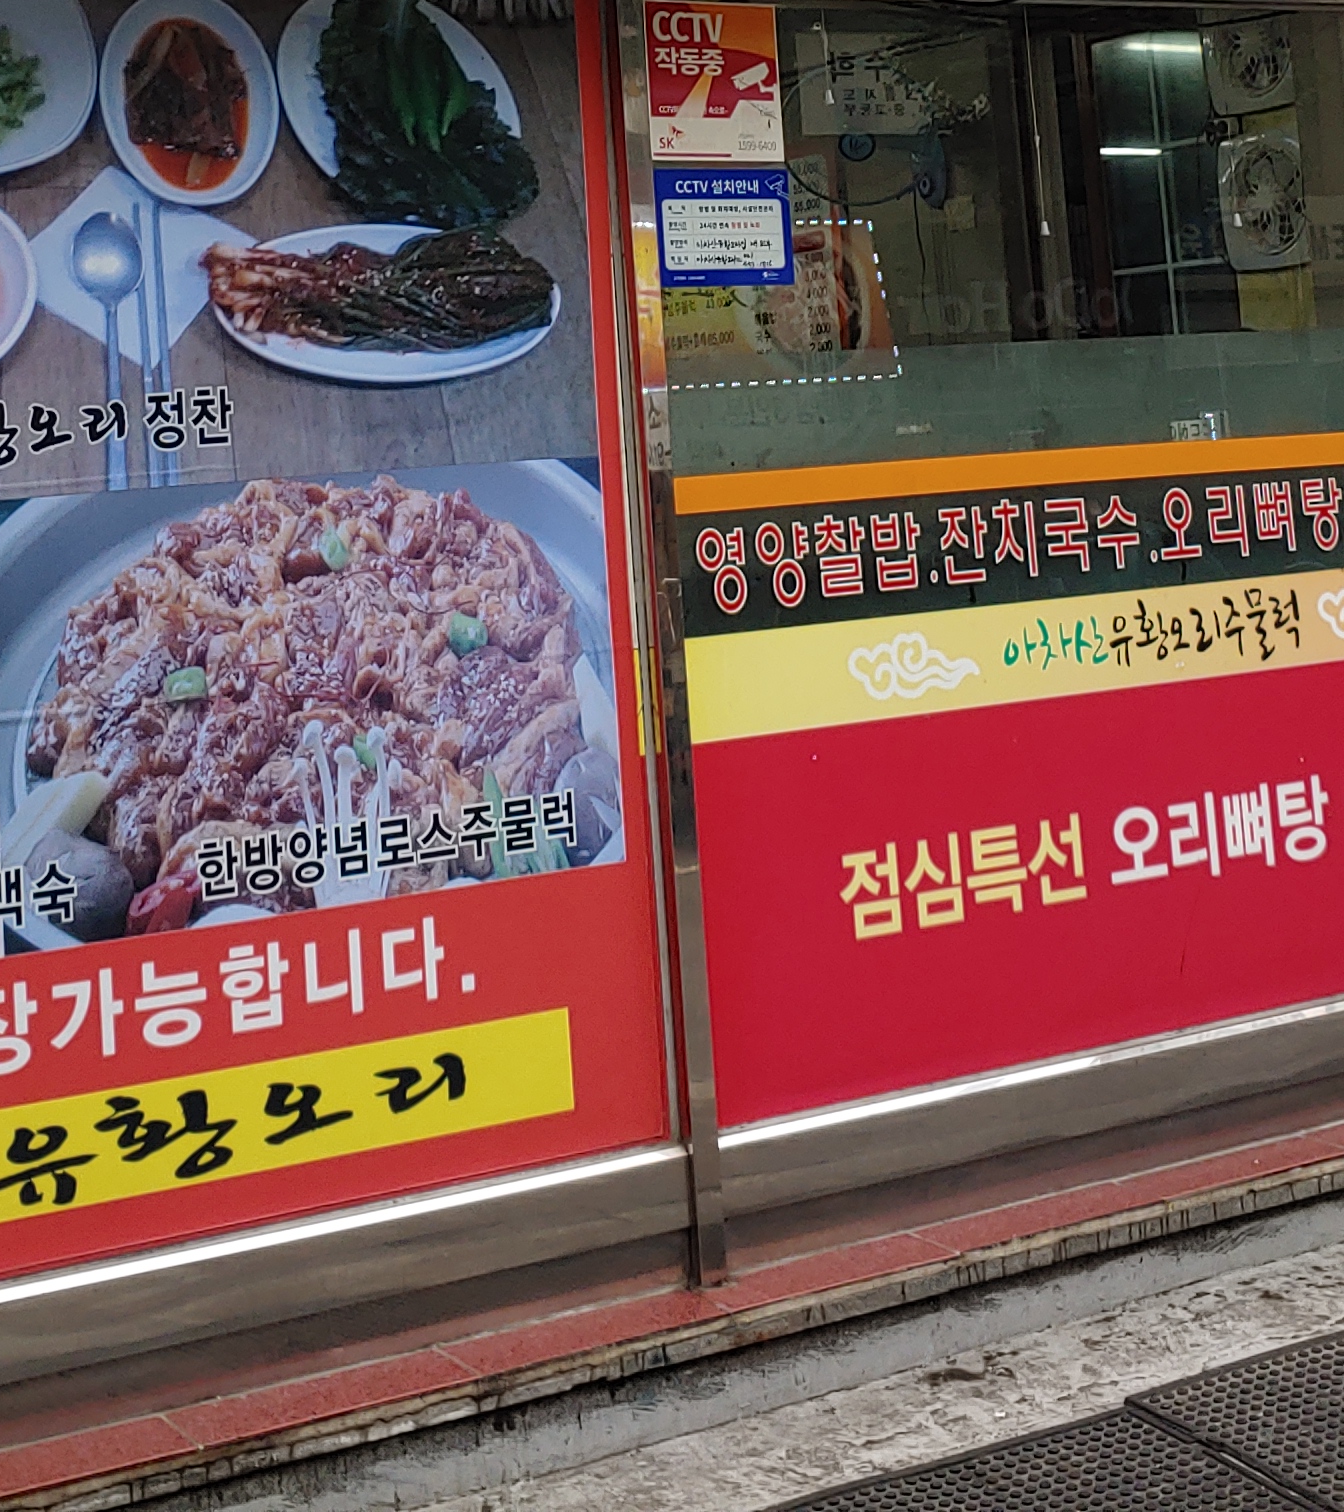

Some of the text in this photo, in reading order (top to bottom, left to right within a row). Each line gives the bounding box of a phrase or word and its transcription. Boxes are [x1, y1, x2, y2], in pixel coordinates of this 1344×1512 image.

[652, 10, 723, 44] CCTV
[654, 47, 725, 76] 작동중
[659, 137, 675, 149] SK
[675, 179, 760, 195] CCTV 설치안내
[141, 385, 235, 450] 정찬
[197, 788, 578, 901] 한방양념로스주물럭
[838, 812, 1088, 941] 점심특선
[1110, 774, 1330, 886] 오리뼈탕
